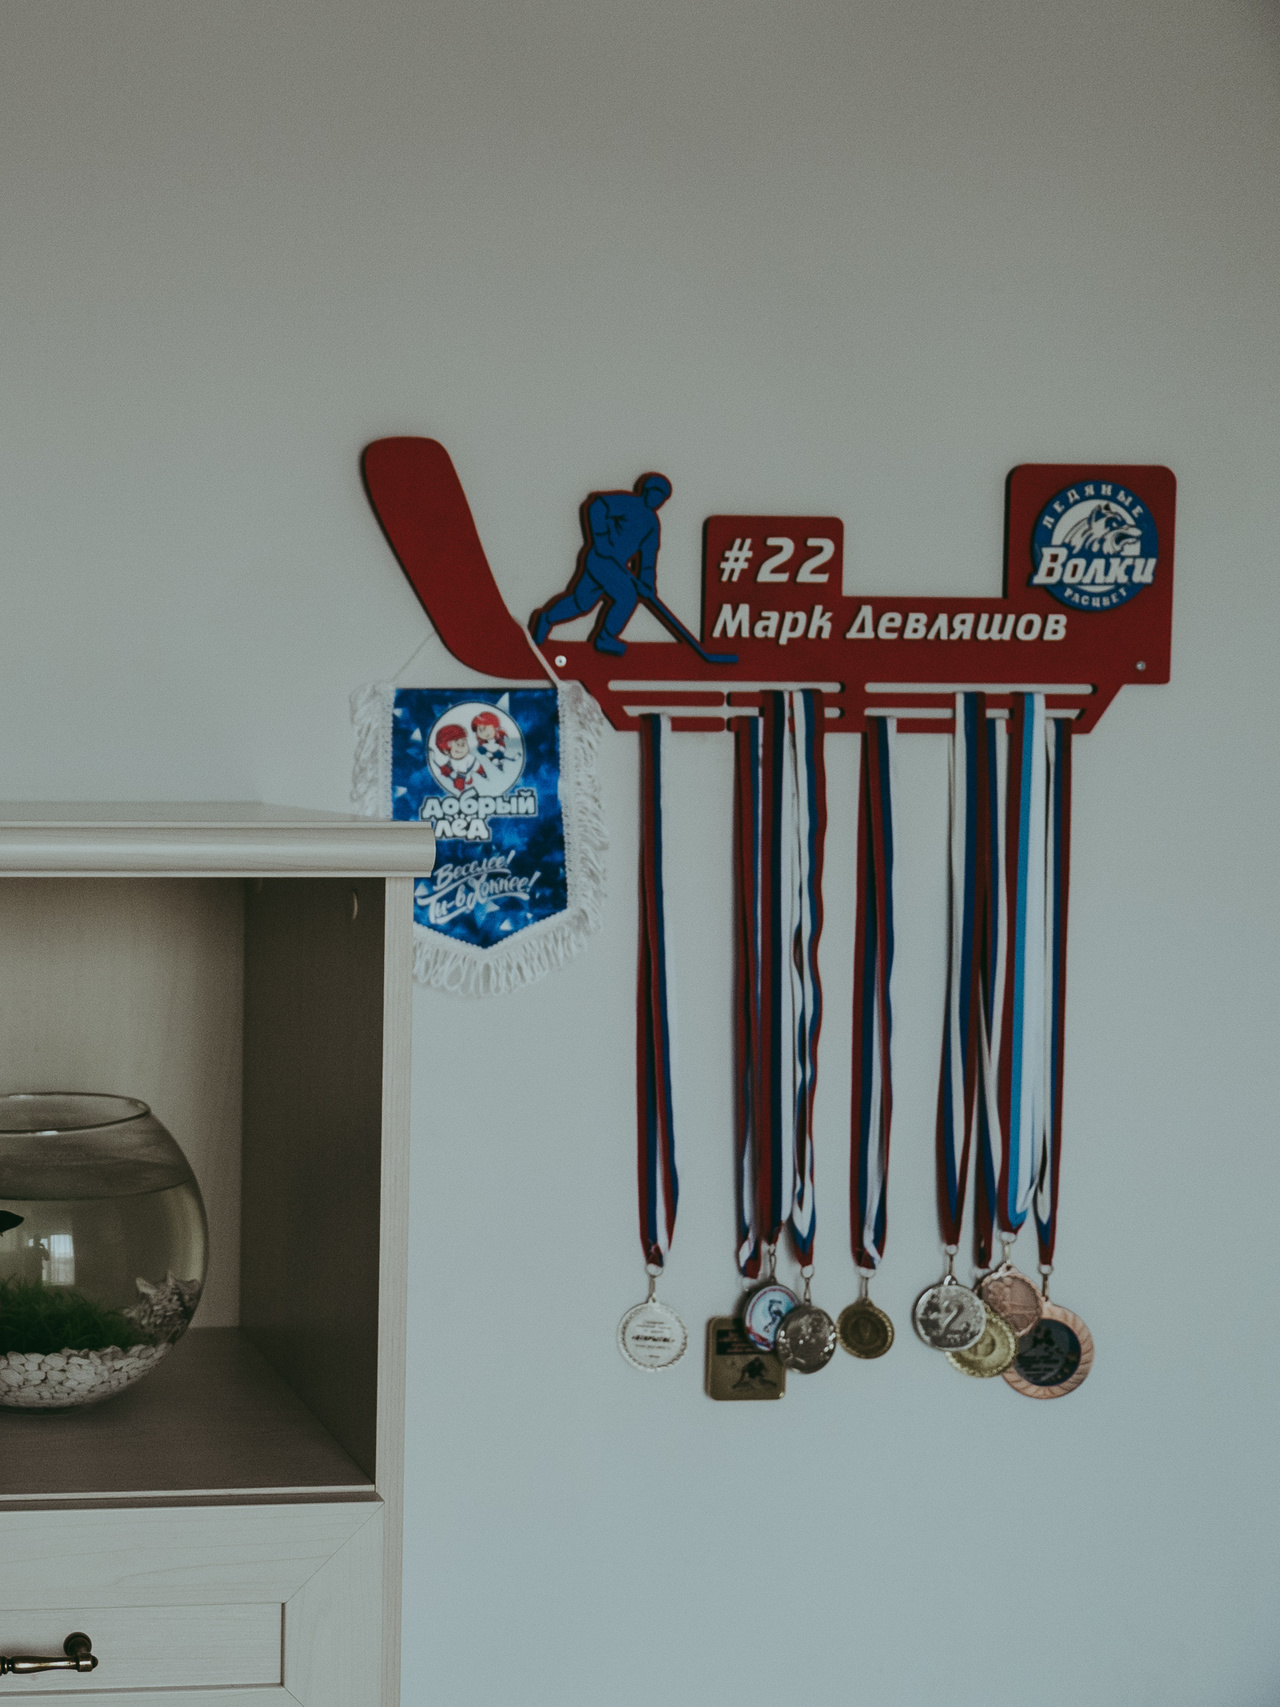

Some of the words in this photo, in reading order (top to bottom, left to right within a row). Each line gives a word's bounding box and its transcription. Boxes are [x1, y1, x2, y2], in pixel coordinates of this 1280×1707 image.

[1042, 484, 1144, 530] ЛЕДЯНЫЕ
[719, 536, 836, 584] #22
[1032, 546, 1157, 585] Волки
[1063, 586, 1128, 608] РАСЦВЕТ
[712, 602, 833, 645] Марк
[845, 602, 1068, 642] Девляшов
[433, 850, 516, 891] Веселее!
